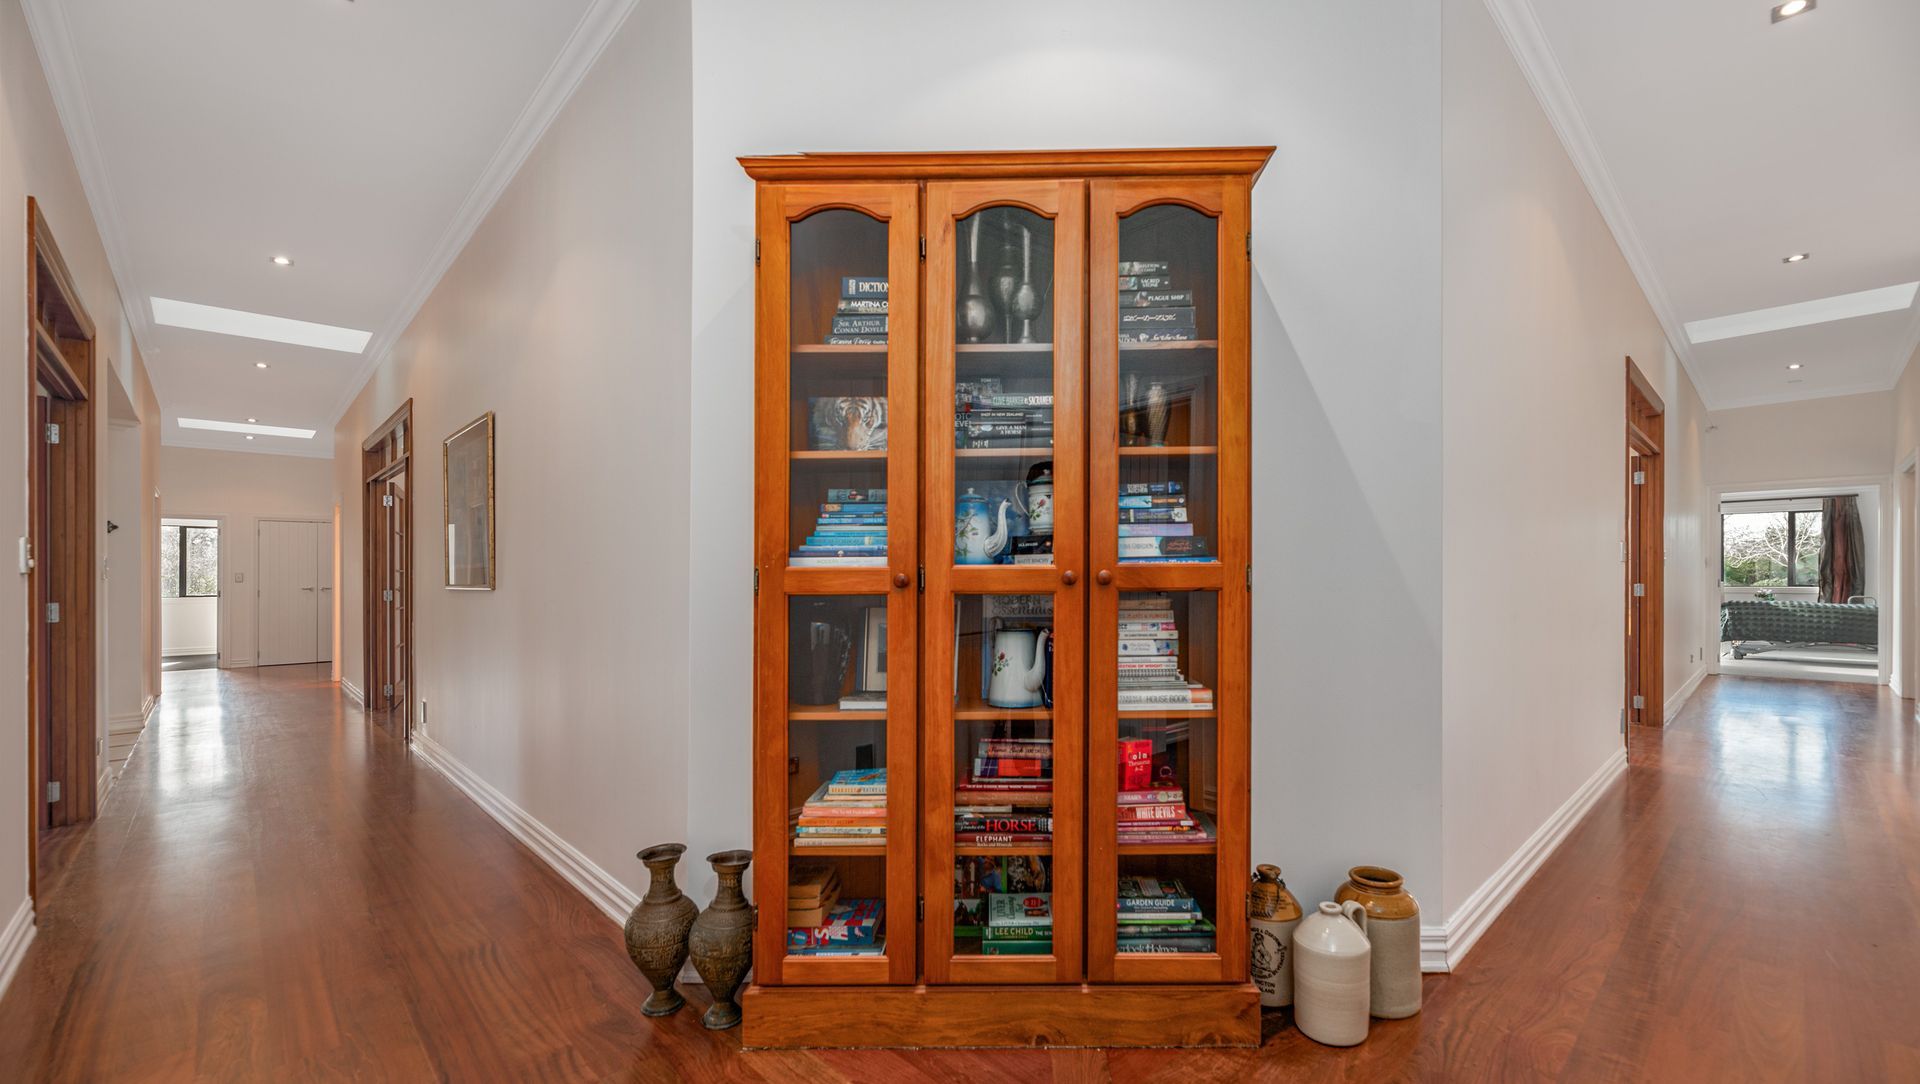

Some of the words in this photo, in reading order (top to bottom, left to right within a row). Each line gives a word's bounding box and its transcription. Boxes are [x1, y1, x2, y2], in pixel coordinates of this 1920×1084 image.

[1145, 695, 1168, 704] HOUSE
[1168, 695, 1188, 703] BOOK
[1135, 806, 1154, 819] WHITE
[1155, 805, 1175, 818] DEVILS
[985, 819, 1037, 832] HORSE
[994, 927, 1009, 935] LEE
[1010, 927, 1034, 935] CHILD
